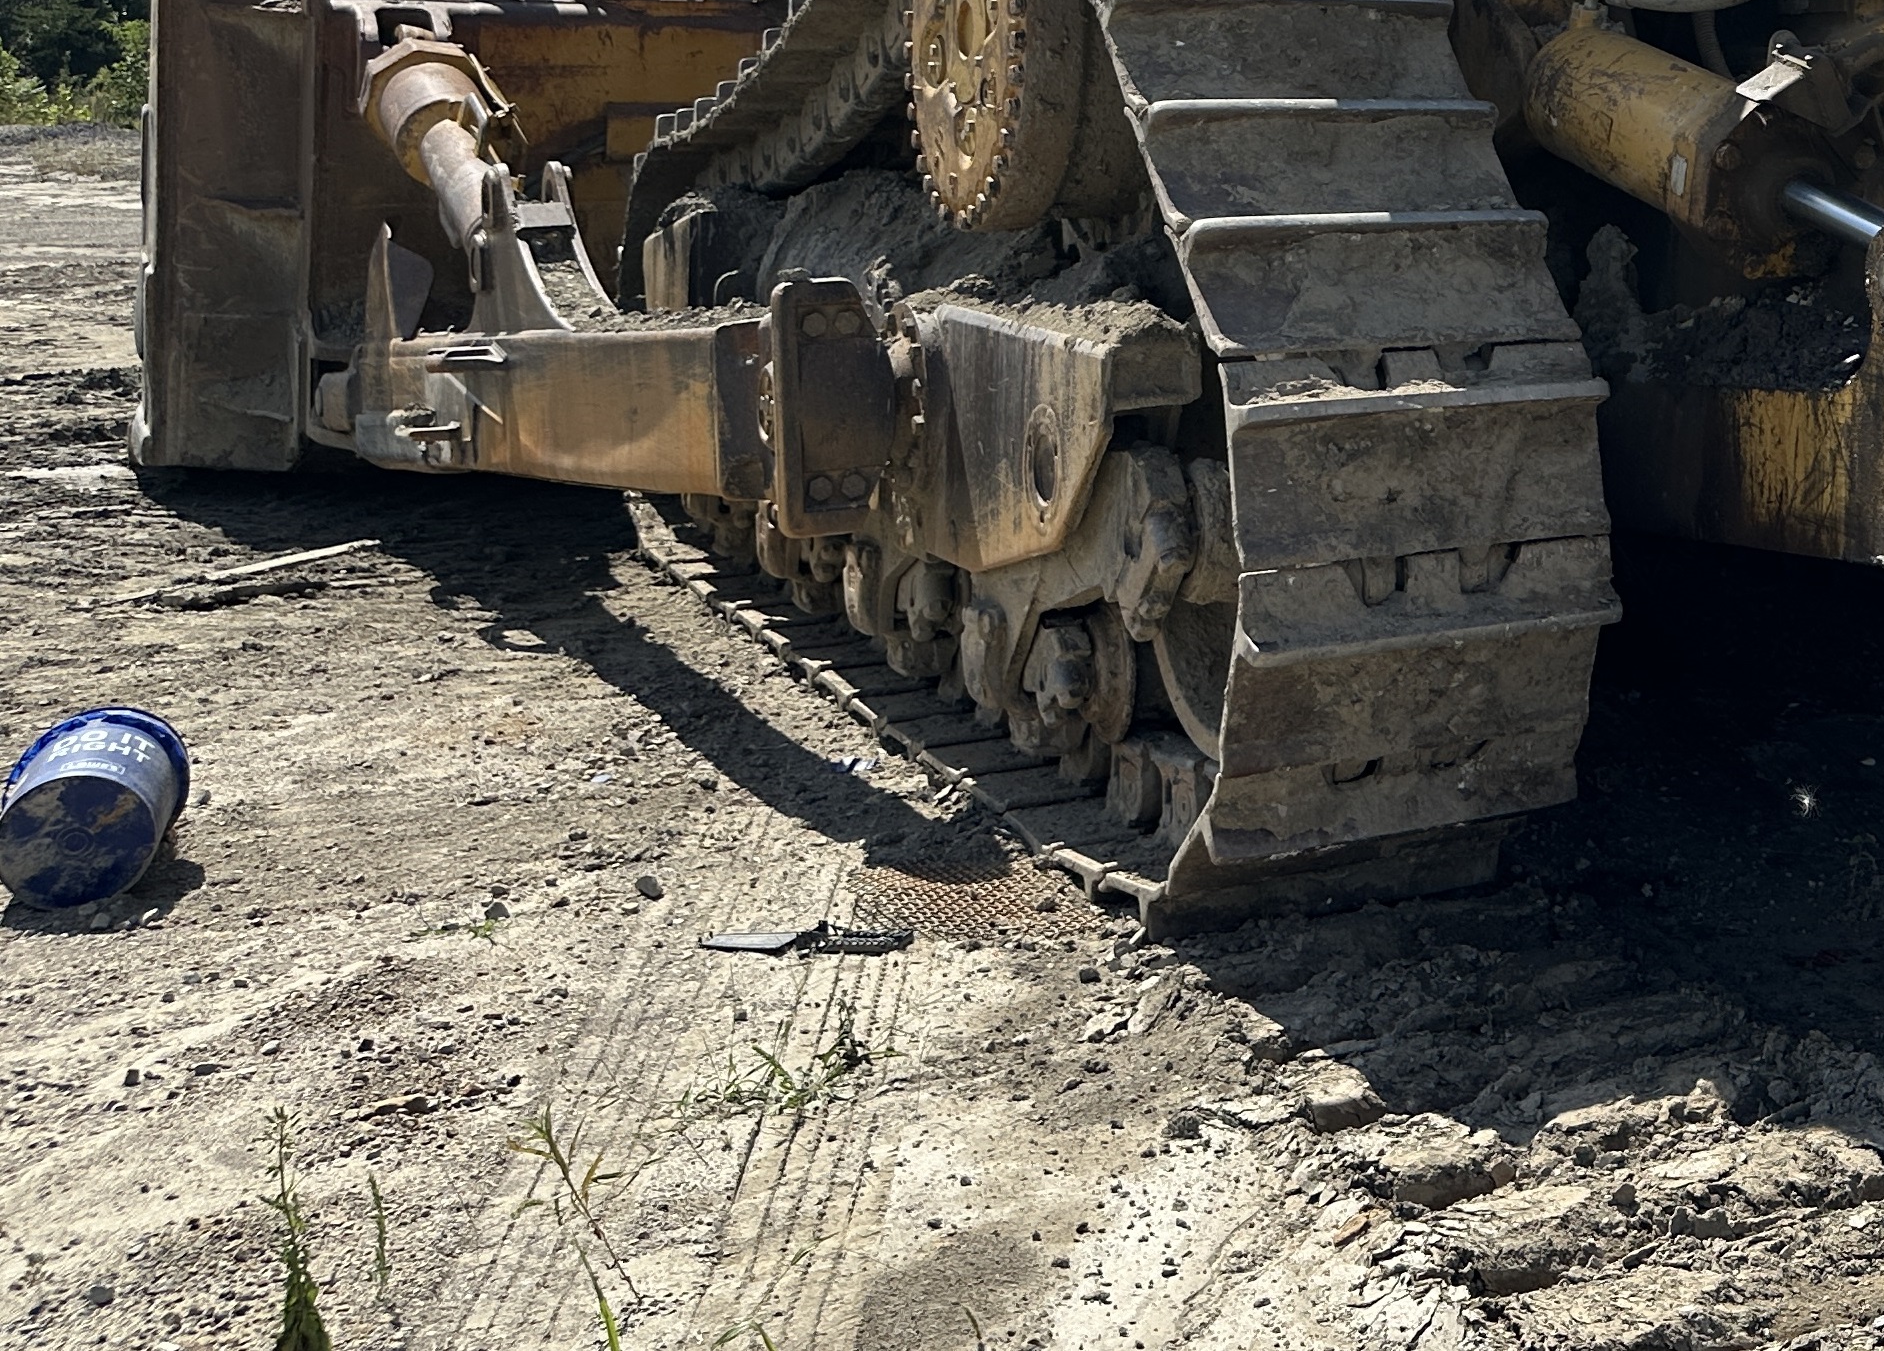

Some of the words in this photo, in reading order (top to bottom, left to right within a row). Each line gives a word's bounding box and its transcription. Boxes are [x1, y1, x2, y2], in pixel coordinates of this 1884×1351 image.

[47, 741, 152, 763] RIGHT
[52, 729, 108, 753] DO
[121, 732, 155, 751] IT
